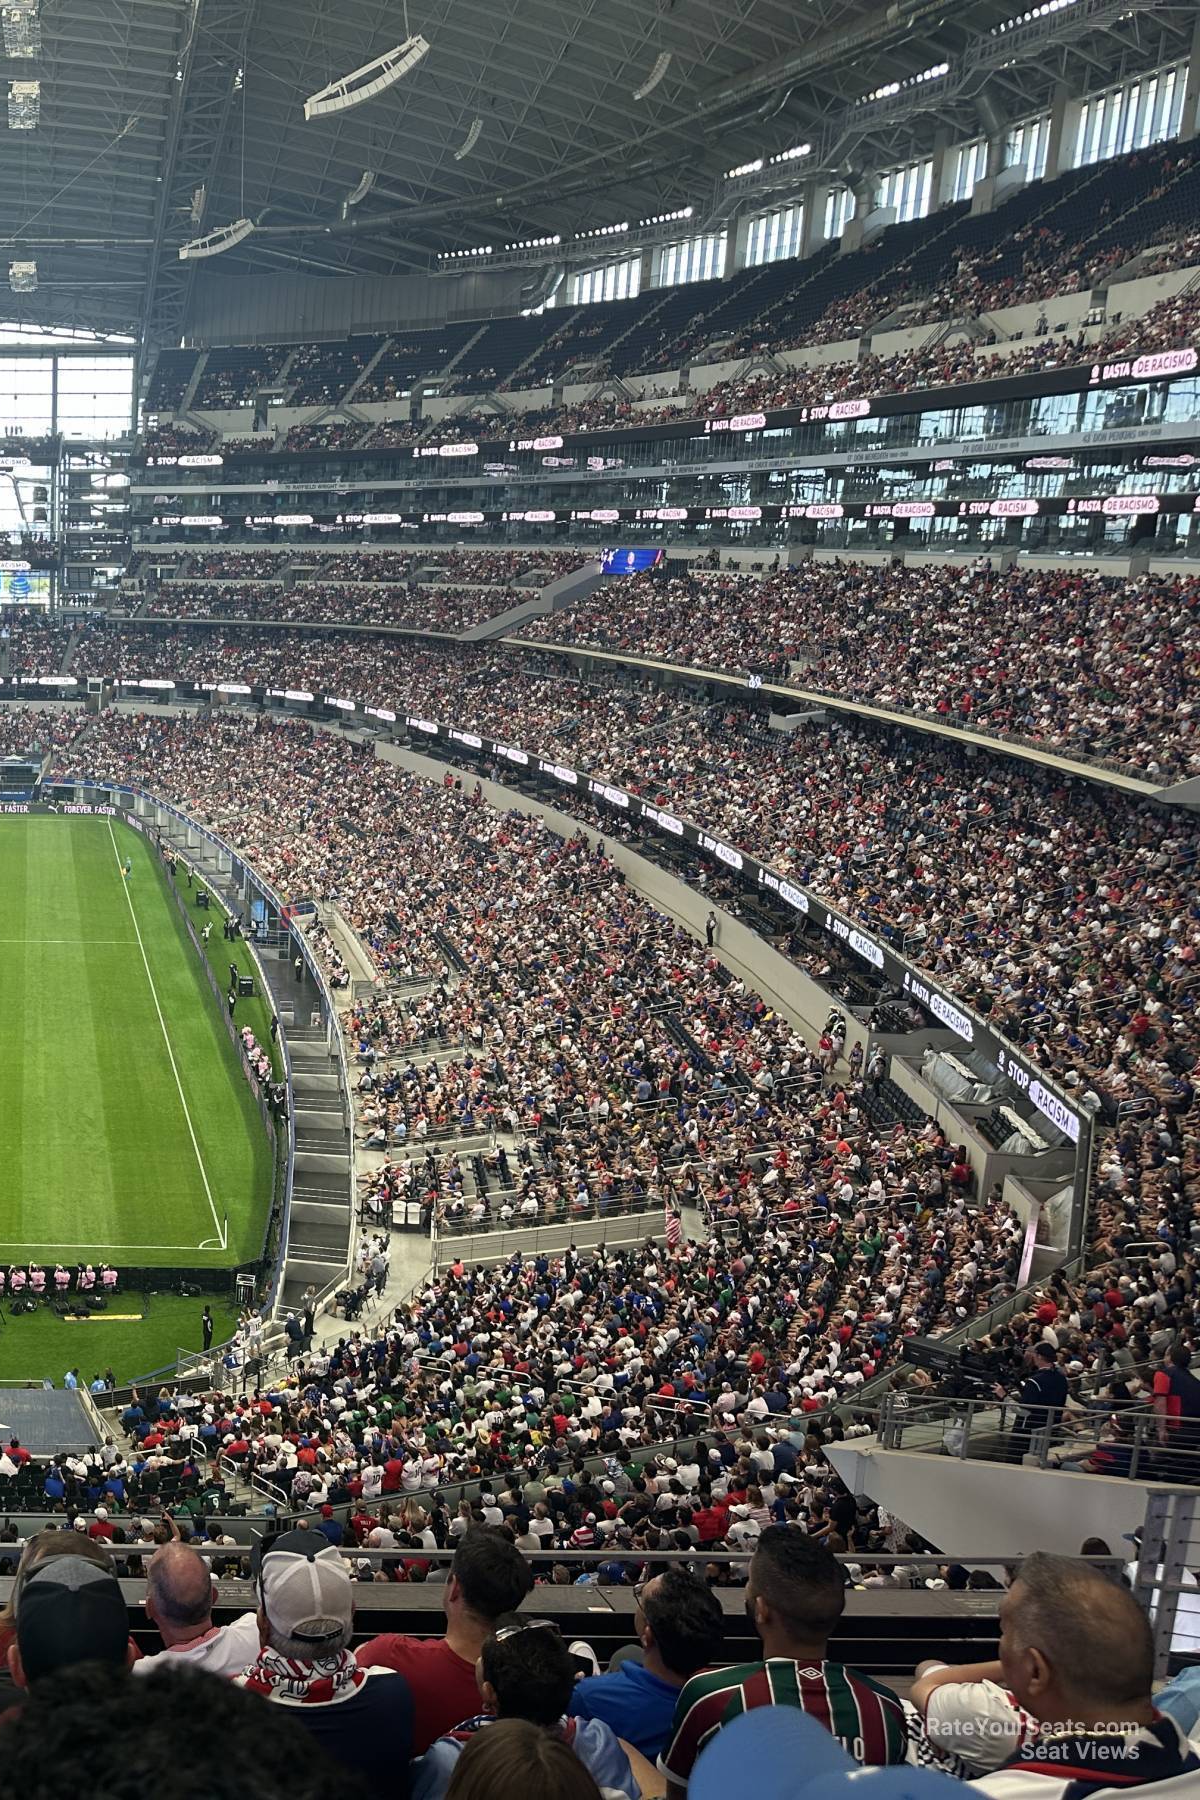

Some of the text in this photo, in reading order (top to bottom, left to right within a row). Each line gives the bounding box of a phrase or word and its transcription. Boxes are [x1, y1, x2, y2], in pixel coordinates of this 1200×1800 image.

[1102, 352, 1192, 379] BASTA DE RACISMO
[810, 403, 860, 420] STOP RACISM
[741, 416, 762, 426] RACISMO
[517, 440, 534, 450] STOP
[156, 457, 177, 465] STOP
[896, 506, 904, 514] DE
[904, 505, 931, 514] RACISMO
[969, 502, 1027, 514] STOP RACISM
[1078, 499, 1154, 512] BASTA DE RACISMO
[642, 510, 657, 518] STOP
[789, 507, 835, 517] STOP RACISM
[345, 515, 362, 523] STOP
[4, 805, 30, 813] FASTER.
[64, 806, 117, 815] FOREVER. FASTER.
[720, 847, 736, 862] RACISM
[834, 919, 877, 959] STOP RACISM
[912, 979, 970, 1037] BASTA DE RACISMO
[1008, 1060, 1069, 1130] STOP RACISM
[372, 1474, 381, 1484] 10
[213, 1498, 218, 1508] 9
